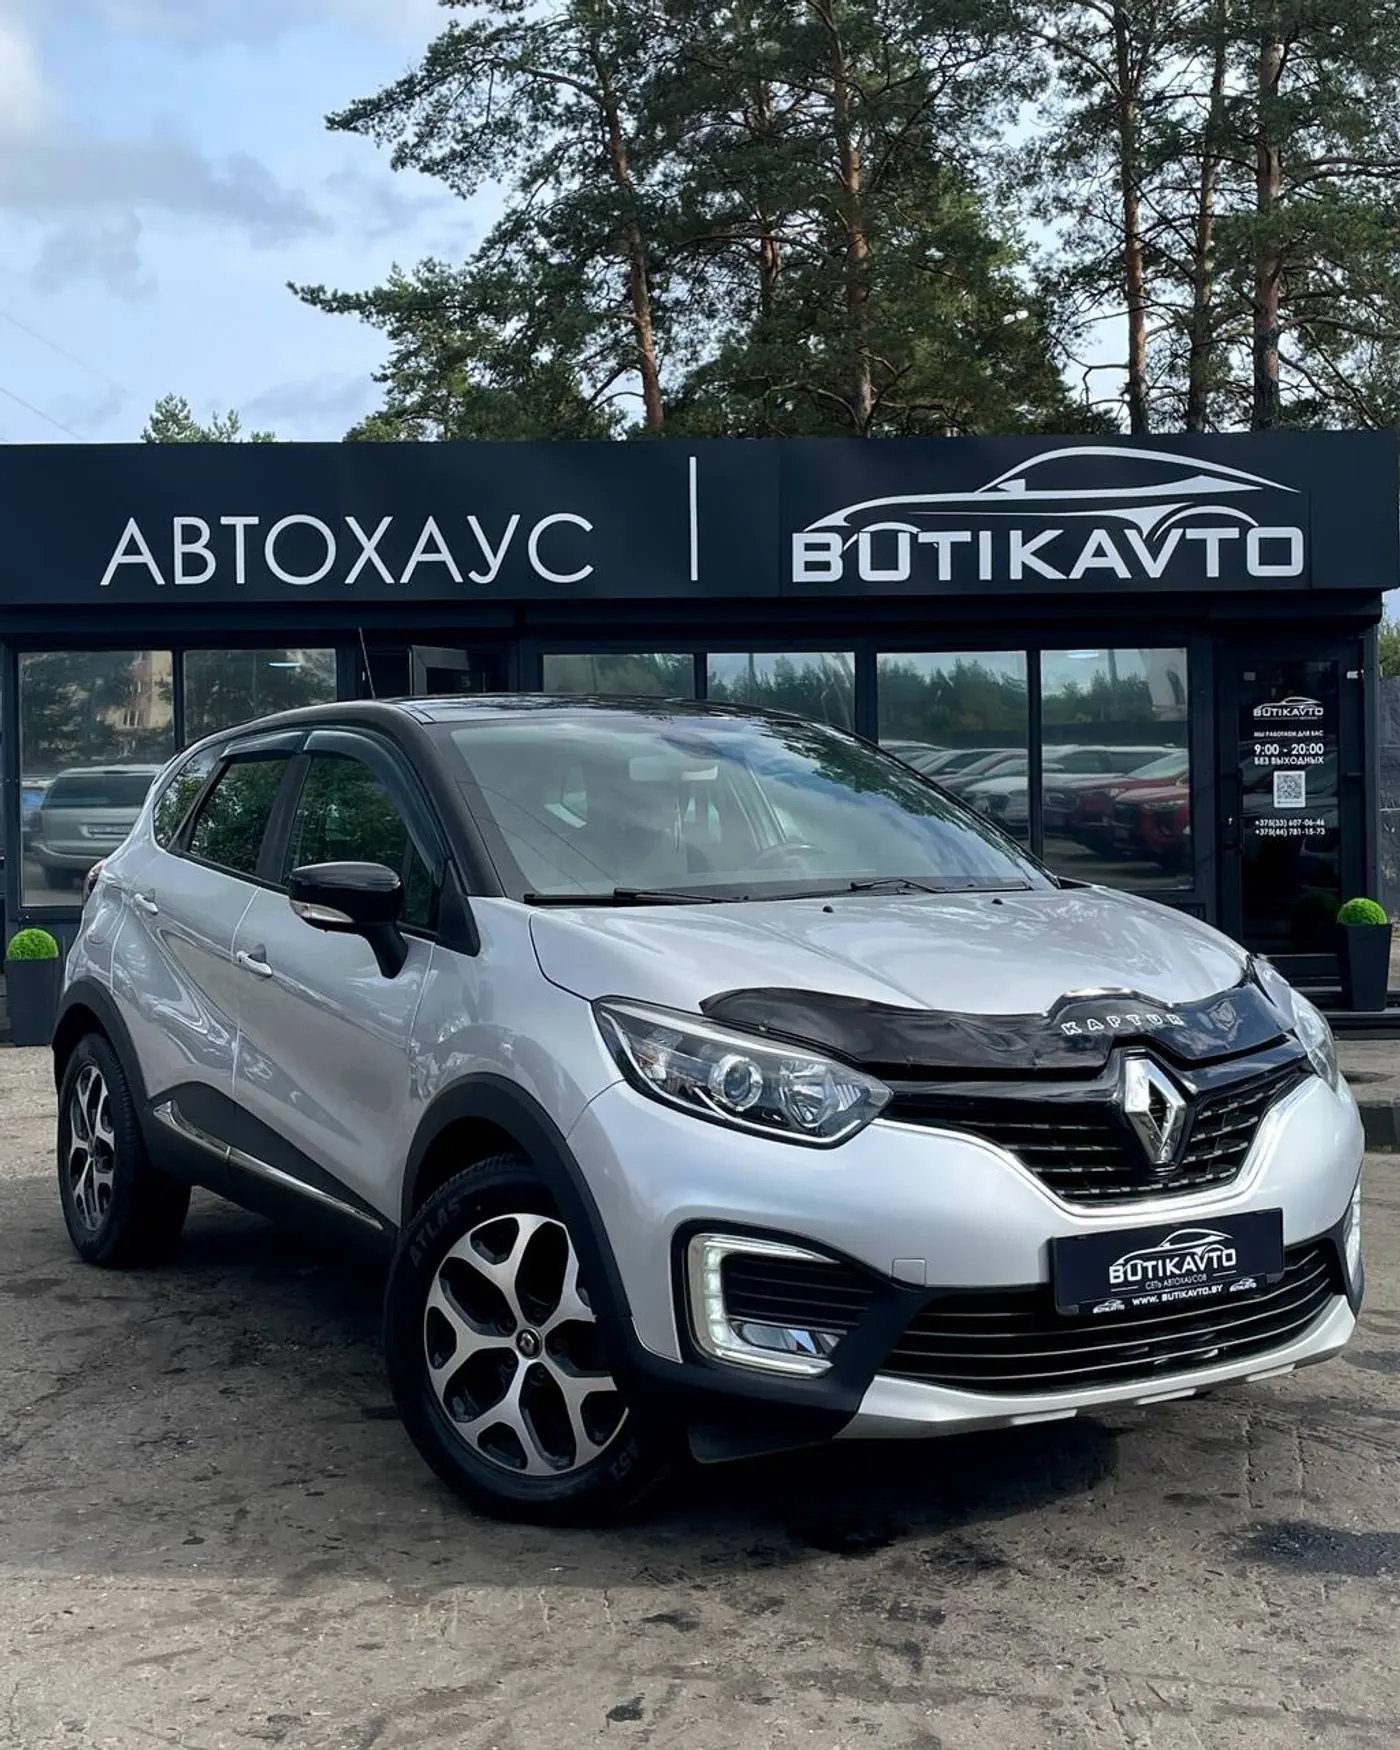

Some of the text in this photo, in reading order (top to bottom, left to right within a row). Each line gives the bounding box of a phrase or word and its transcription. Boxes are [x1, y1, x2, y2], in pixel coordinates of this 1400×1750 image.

[100, 512, 595, 586] АВТОХАУС
[791, 526, 1304, 584] BUTIKAVTO
[1253, 707, 1324, 717] BUTIKAVTO
[1254, 743, 1280, 756] 9:00
[1291, 743, 1325, 755] 20:00
[1254, 756, 1325, 766] БЕЗ ВЫХОДНЫХ
[1060, 1013, 1185, 1036] KAPTUR
[408, 1196, 462, 1269] ATLAS
[1108, 1248, 1237, 1285] BUTIKAVTO
